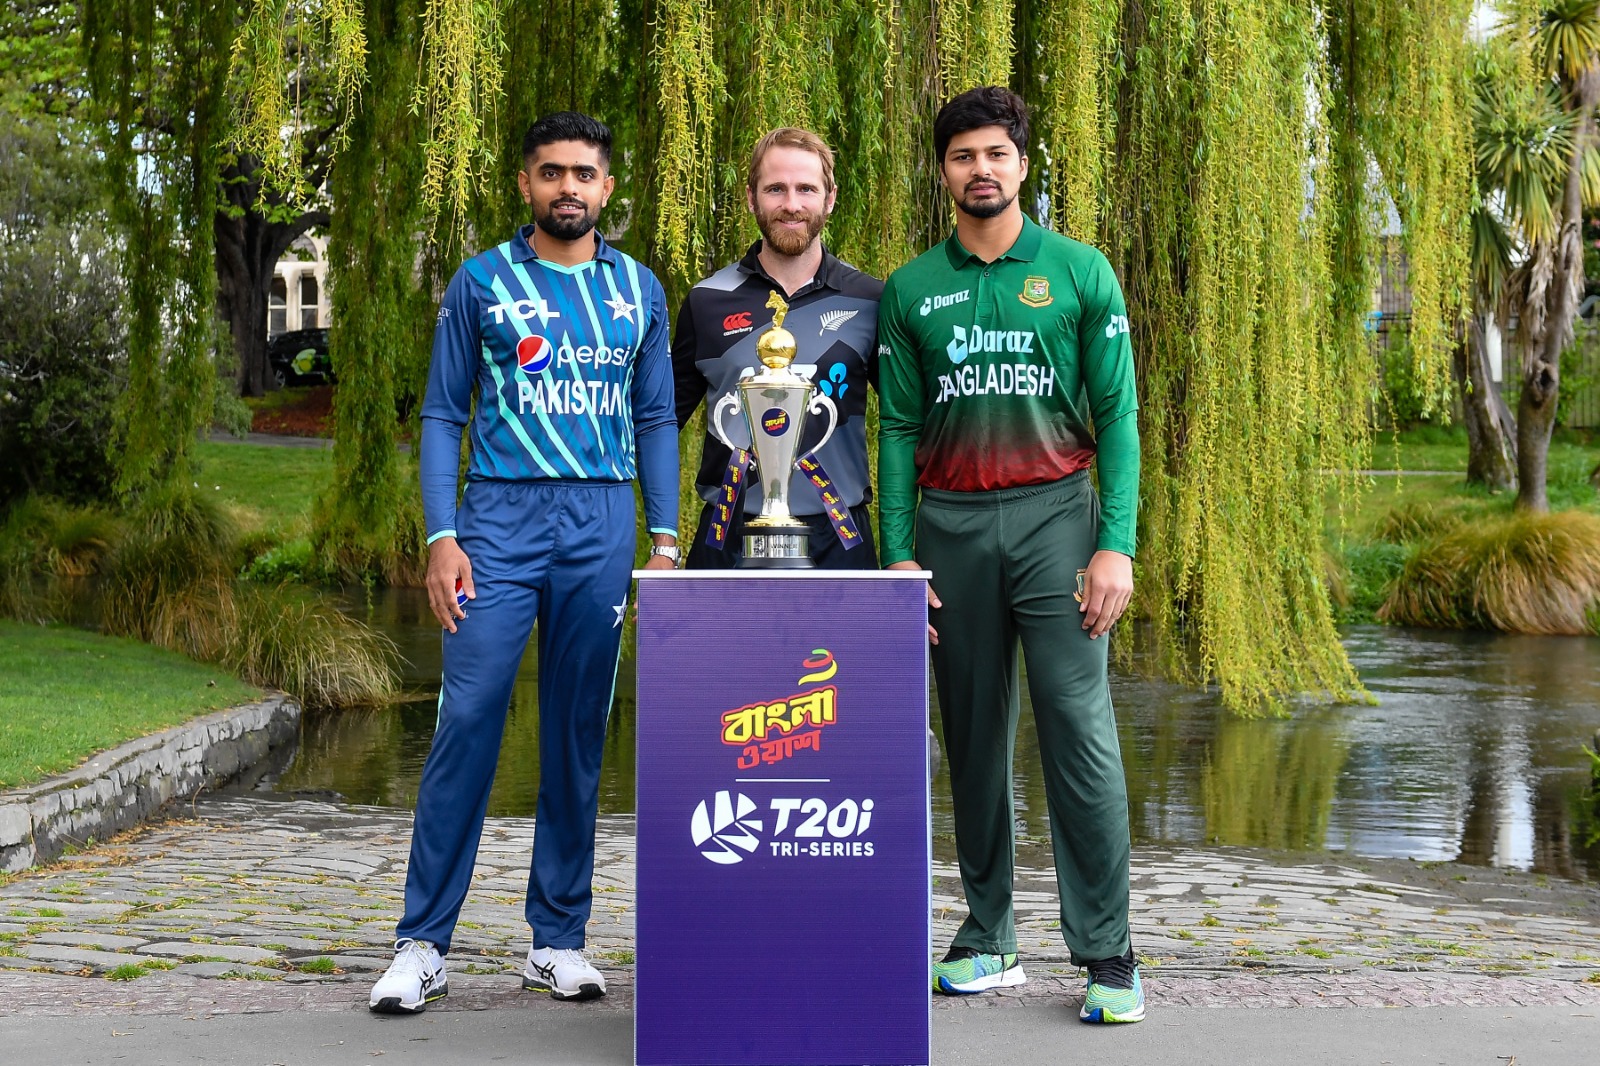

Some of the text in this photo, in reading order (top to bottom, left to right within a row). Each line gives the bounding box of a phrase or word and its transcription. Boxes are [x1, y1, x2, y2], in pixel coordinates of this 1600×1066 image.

[487, 299, 560, 324] TCL
[934, 289, 970, 310] Daraz
[968, 325, 1035, 354] Daraz
[556, 345, 631, 370] pepsi
[517, 379, 622, 417] PAKISTAN
[721, 685, 836, 743] বাংলা
[770, 797, 875, 838] T20i
[770, 842, 875, 856] TRI-SERIES
